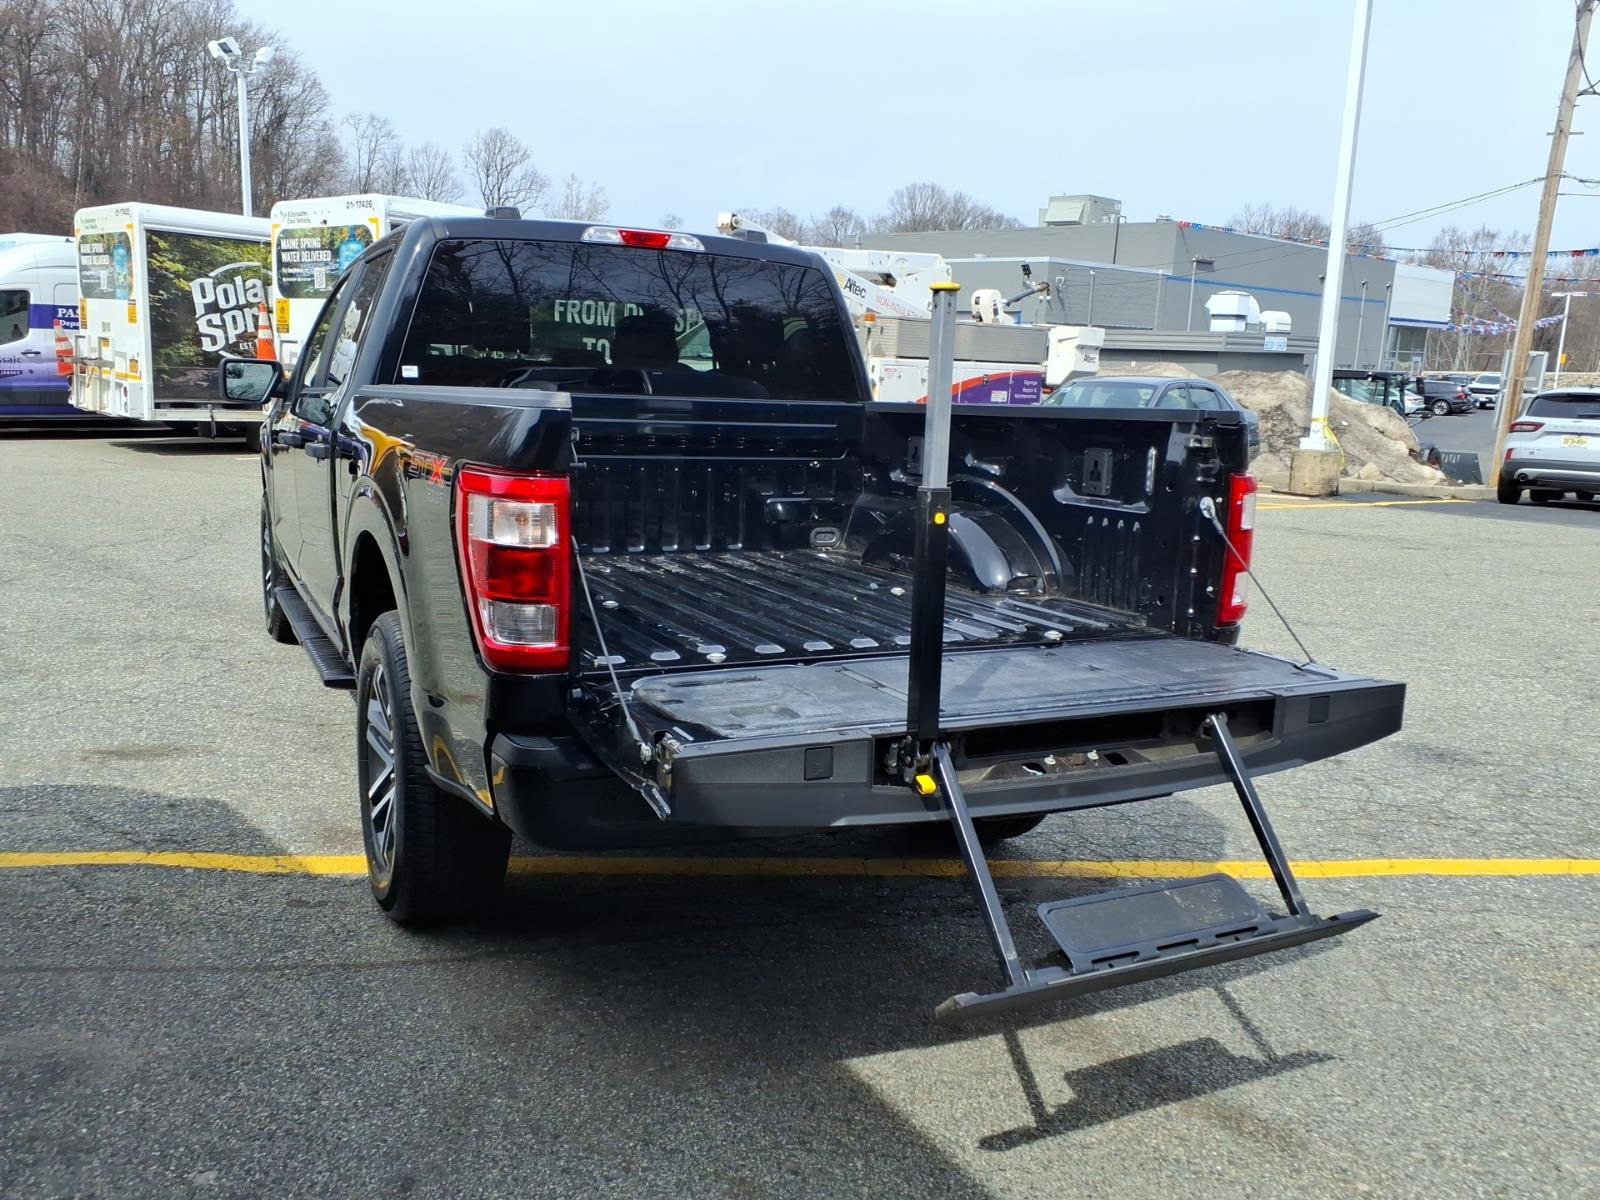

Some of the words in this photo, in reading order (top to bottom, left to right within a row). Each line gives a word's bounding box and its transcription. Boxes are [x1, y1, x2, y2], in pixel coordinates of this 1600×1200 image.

[281, 238, 299, 249] MAINE
[301, 237, 321, 248] SPRING
[282, 251, 300, 263] WATER
[301, 250, 331, 262] DELIVERED
[189, 275, 264, 318] Pola
[844, 278, 867, 298] Altec
[554, 299, 616, 327] FROM
[196, 306, 260, 352] Spr
[0, 355, 22, 363] saic
